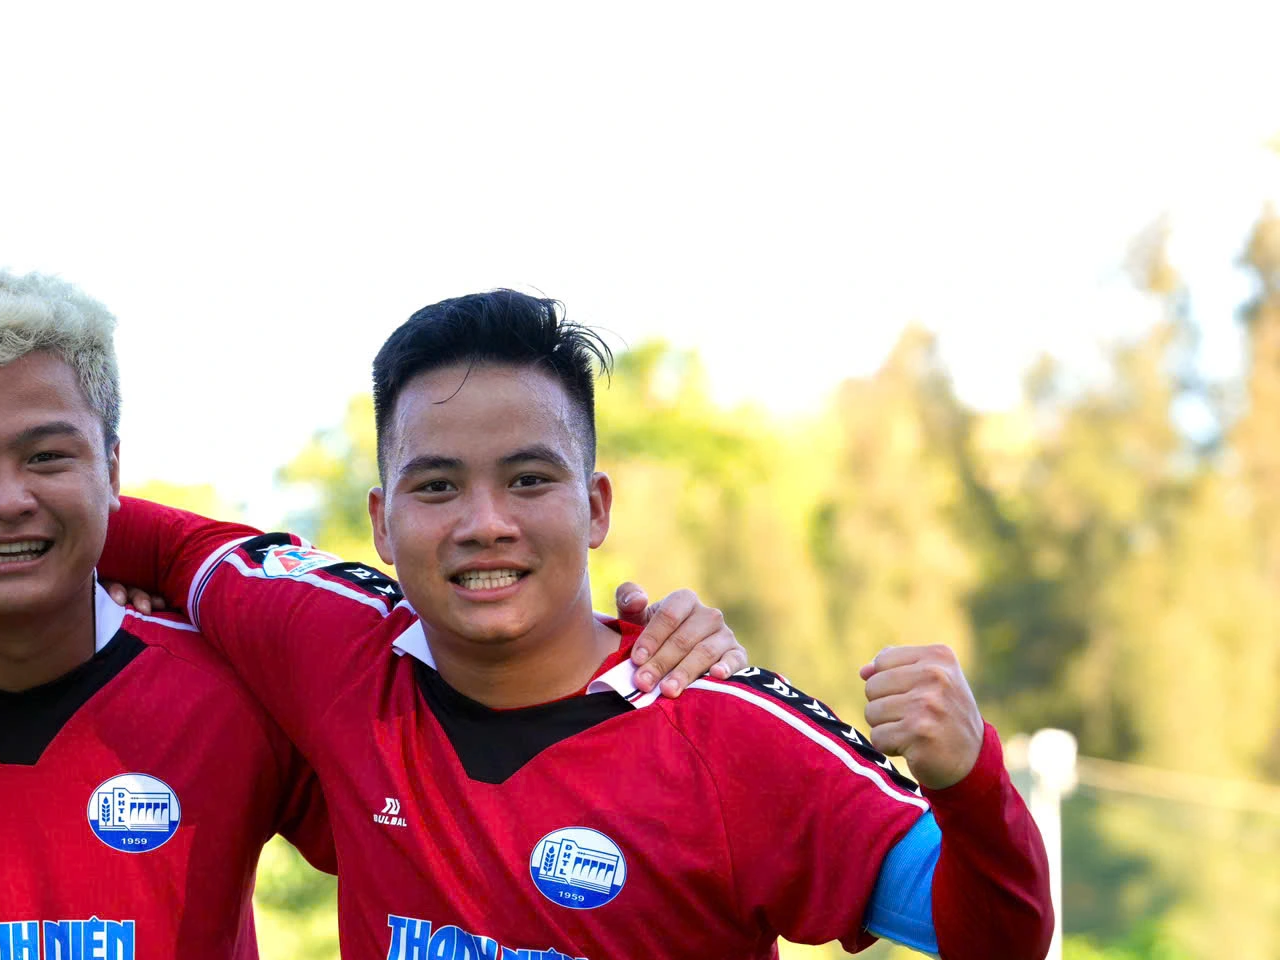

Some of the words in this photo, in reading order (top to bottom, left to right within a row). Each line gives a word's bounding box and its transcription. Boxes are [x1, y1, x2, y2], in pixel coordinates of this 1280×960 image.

[373, 814, 408, 827] BULBAL
[121, 837, 148, 845] 1959
[558, 891, 585, 902] 1959
